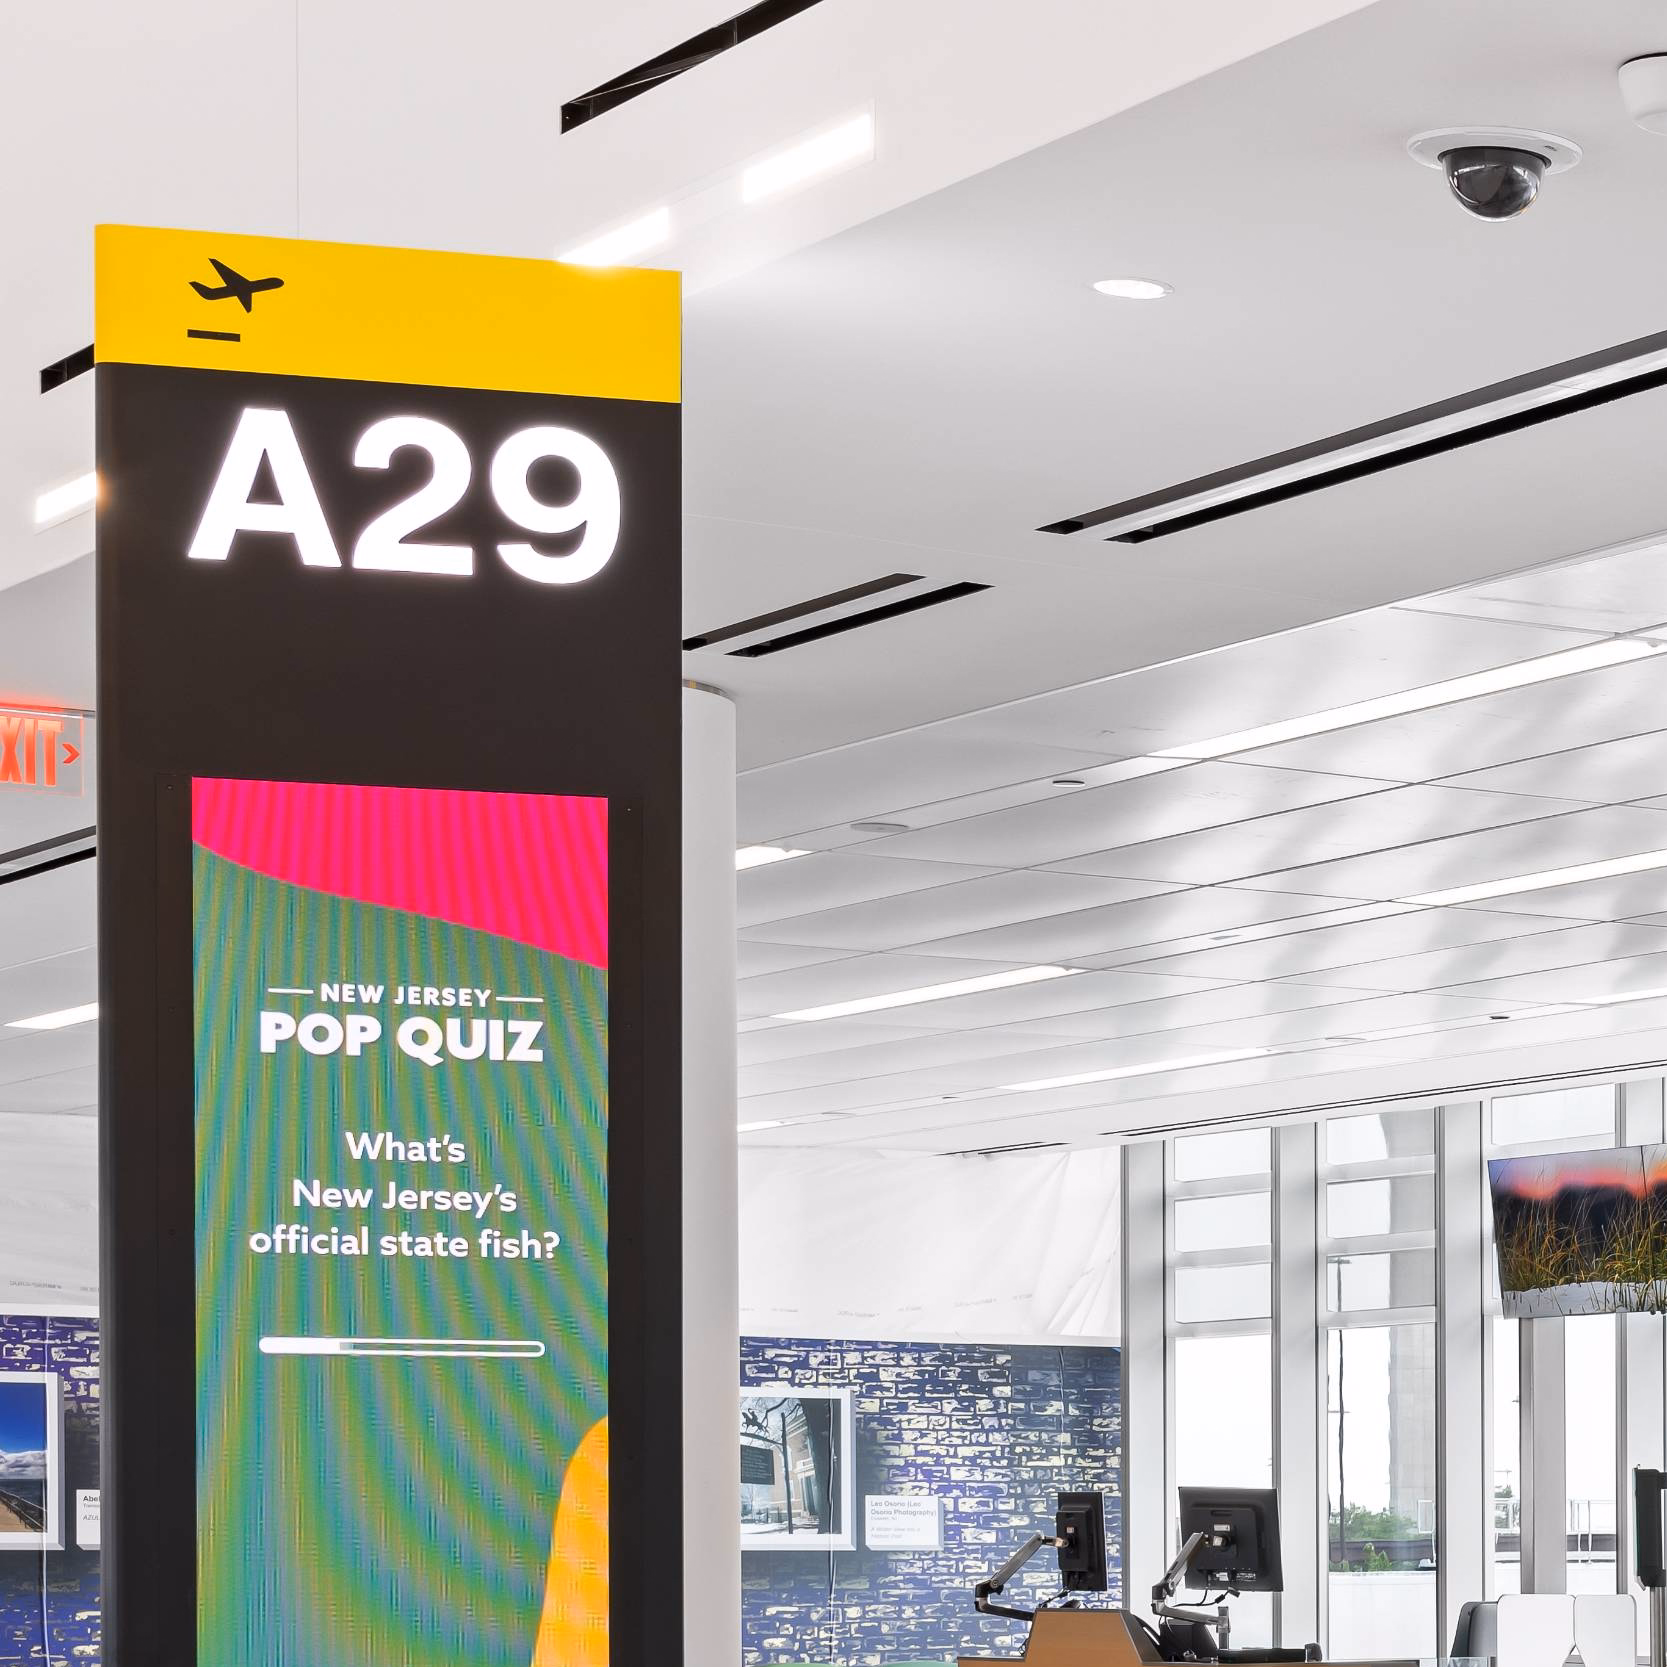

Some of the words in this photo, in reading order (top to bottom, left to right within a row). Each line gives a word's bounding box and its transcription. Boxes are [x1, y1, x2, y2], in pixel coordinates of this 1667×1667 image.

[187, 407, 621, 585] A29
[0, 715, 63, 788] XIT
[320, 983, 384, 1004] NEW
[394, 986, 492, 1008] JERSEY
[260, 1011, 382, 1056] POP
[397, 1017, 544, 1067] QUIZ
[345, 1131, 466, 1163] What's
[293, 1179, 373, 1209] New
[382, 1181, 518, 1218] Jersey's
[249, 1225, 369, 1256] official
[380, 1228, 469, 1258] state
[478, 1230, 560, 1260] fish?
